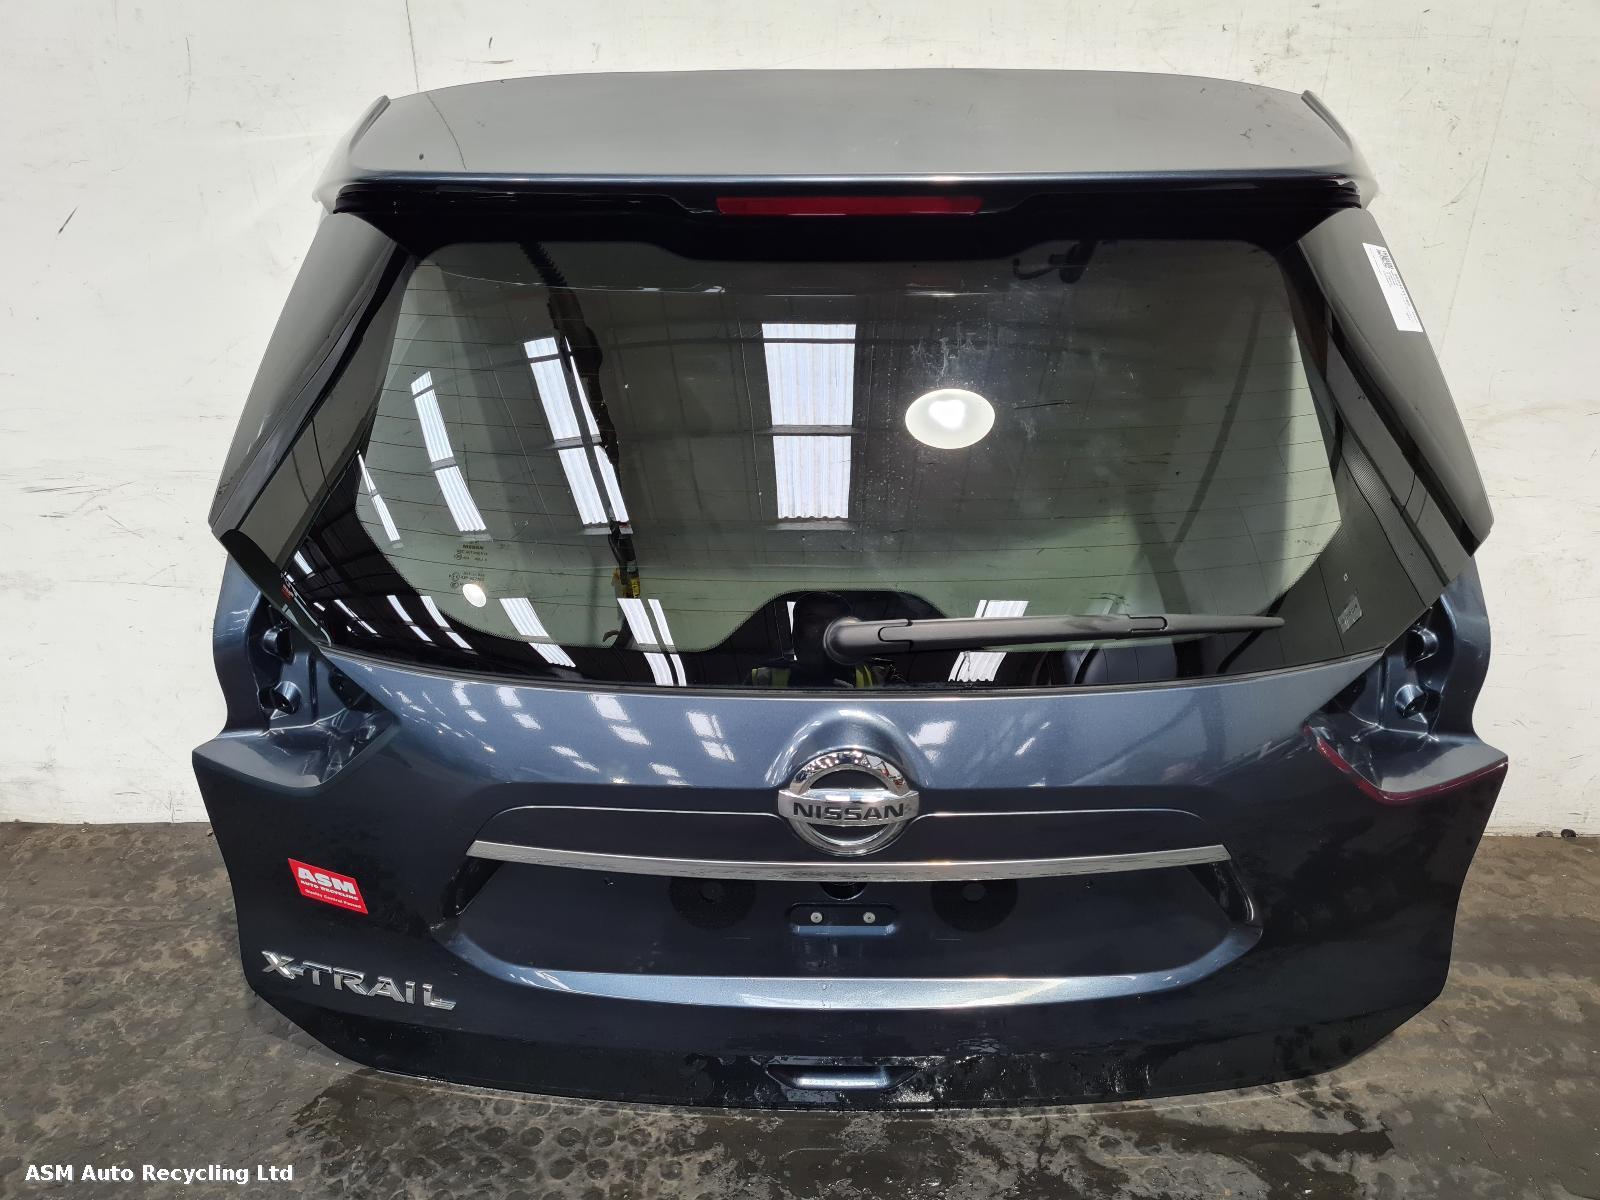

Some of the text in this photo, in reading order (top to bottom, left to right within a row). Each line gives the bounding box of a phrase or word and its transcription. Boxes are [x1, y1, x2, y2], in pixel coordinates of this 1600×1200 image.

[793, 802, 904, 820] NISSAN
[298, 867, 356, 895] ASM
[300, 880, 359, 901] AUTO RECYCLING
[261, 951, 457, 1010] X-TRAIL
